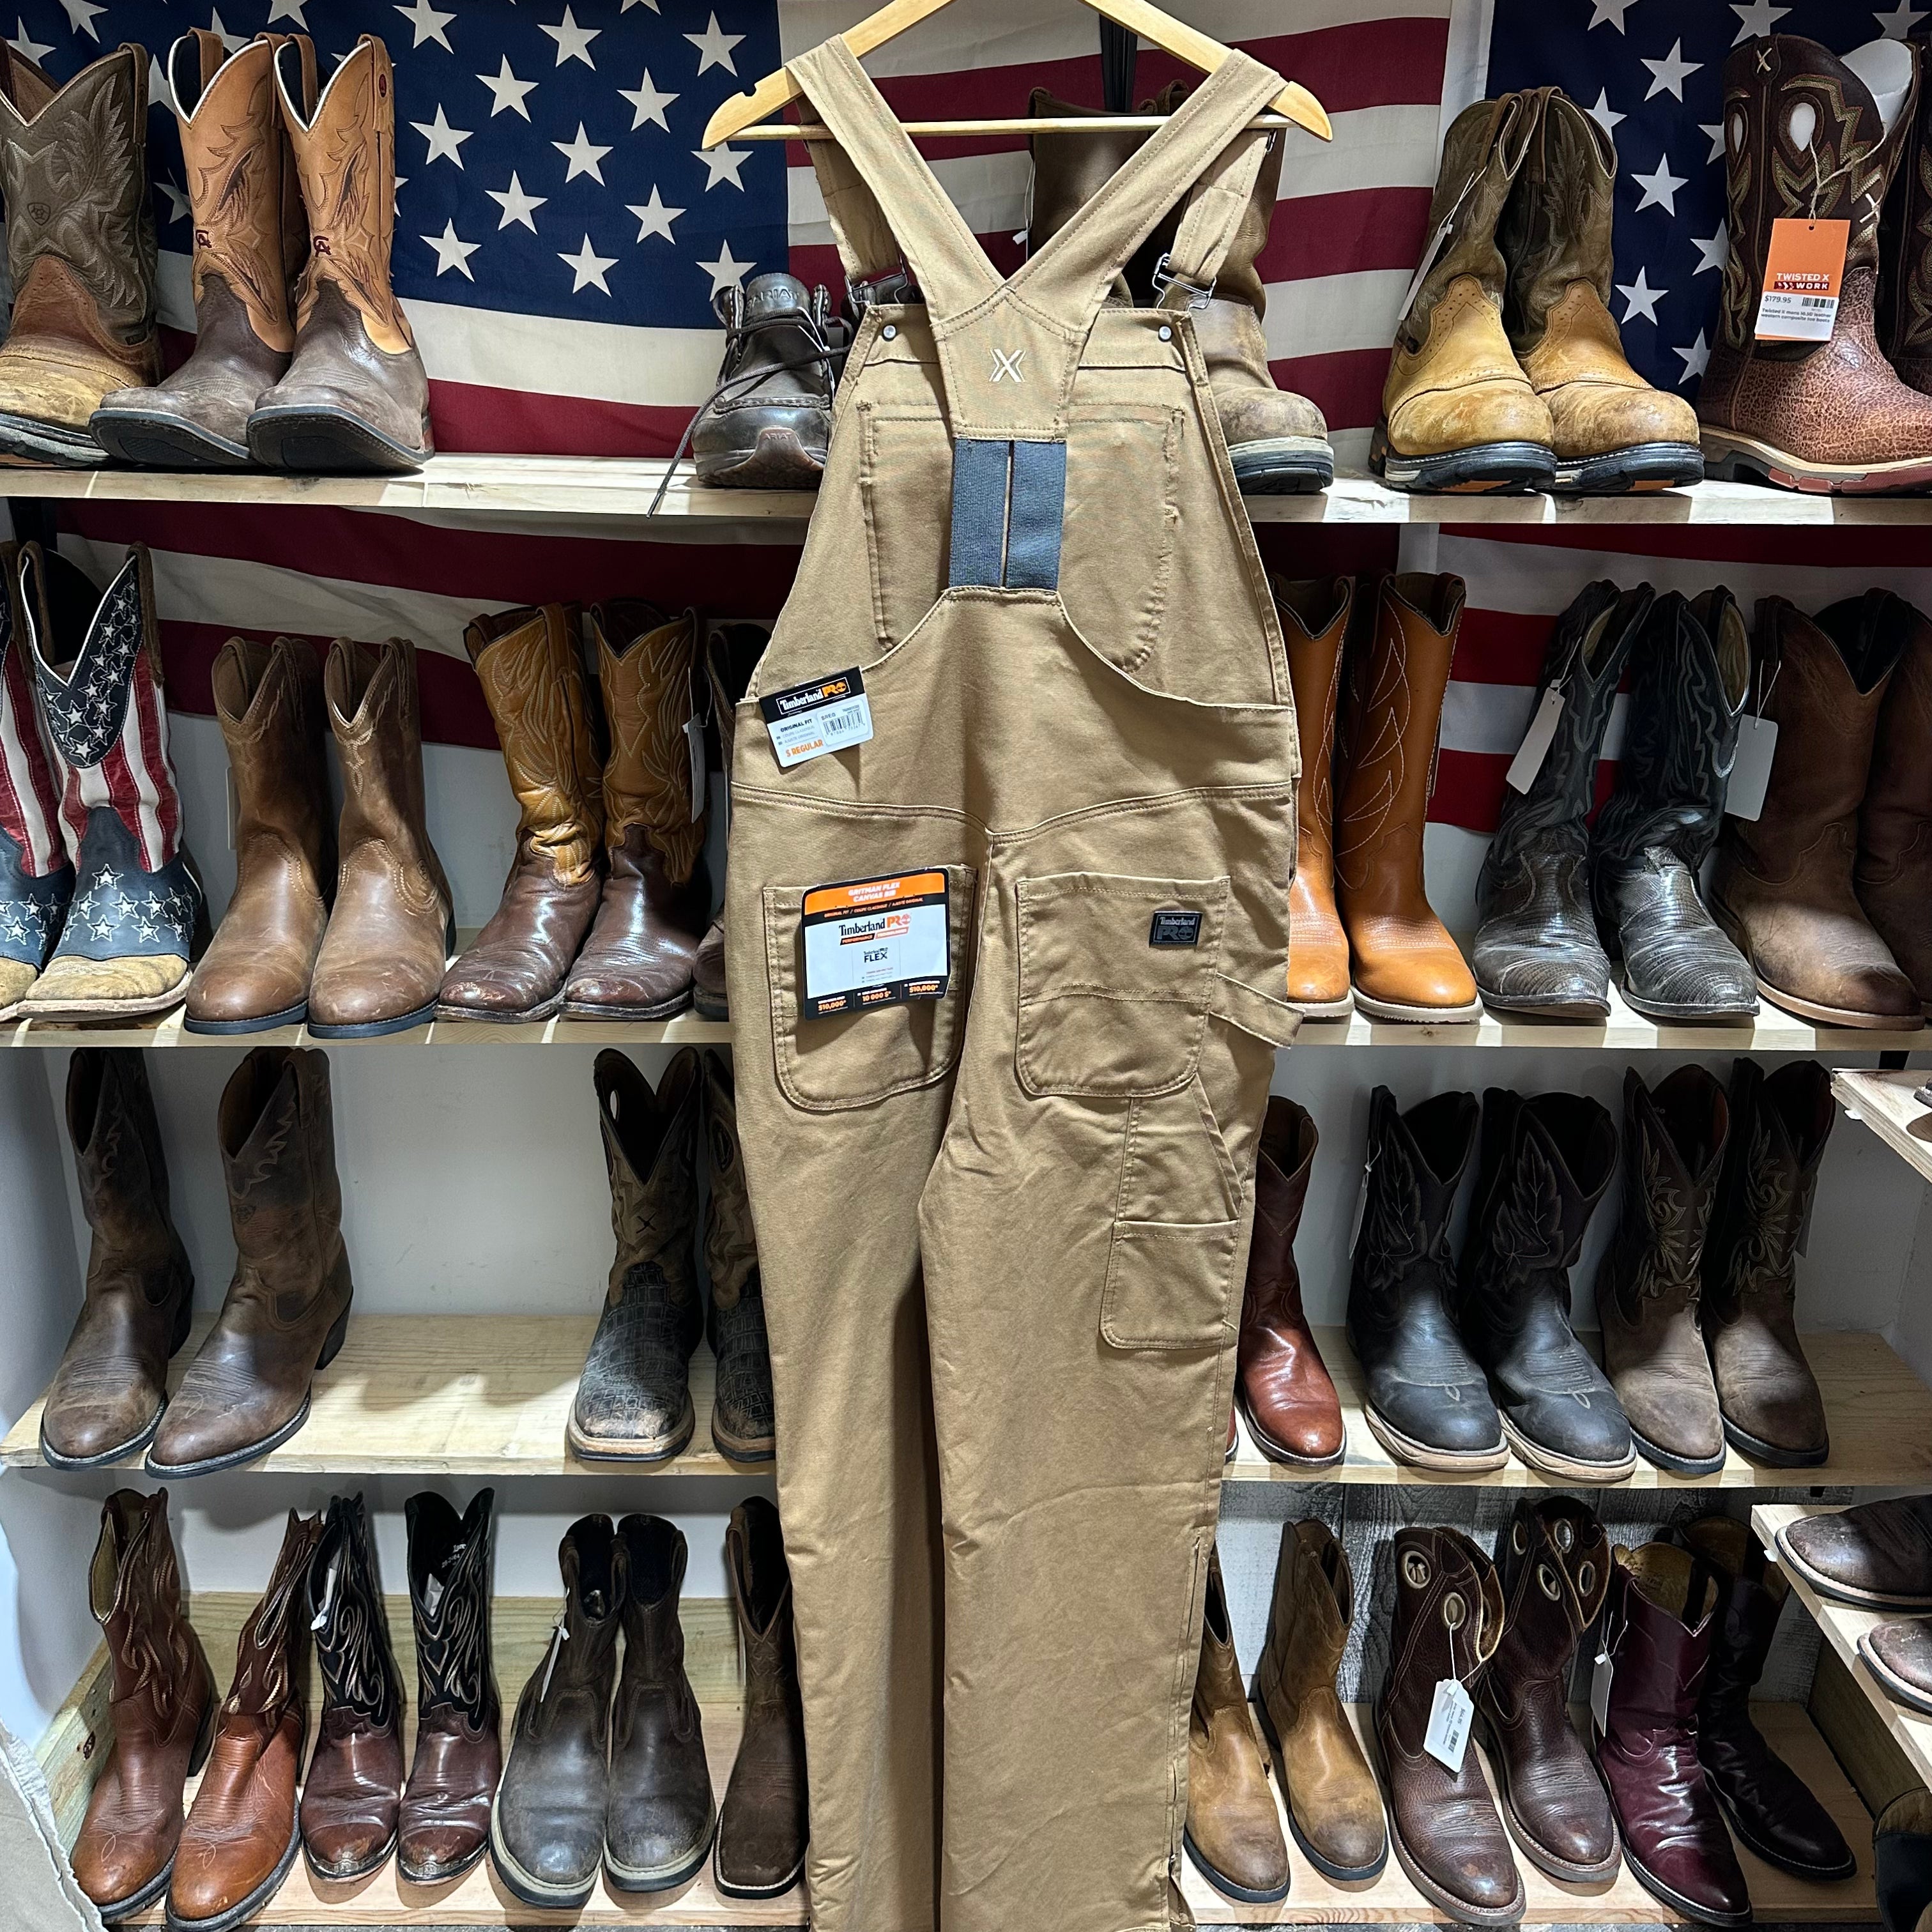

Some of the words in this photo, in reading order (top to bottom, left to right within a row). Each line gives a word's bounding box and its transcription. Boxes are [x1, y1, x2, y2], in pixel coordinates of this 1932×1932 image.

[1777, 273, 1820, 281] TWISTED
[1765, 295, 1791, 303] $179.95
[779, 688, 824, 710] Timberland
[822, 681, 847, 698] PRO
[780, 721, 804, 733] ORIGINAL
[785, 749, 792, 758] S
[791, 739, 824, 756] REGULAR
[848, 884, 882, 897] GRITMAN
[882, 881, 901, 890] FLEX
[853, 891, 884, 903] CANVAS
[838, 917, 885, 937] Timberland
[886, 912, 912, 928] PRO
[1160, 916, 1196, 926] Timberland
[1156, 925, 1194, 940] PRO
[864, 952, 888, 963] FLEX
